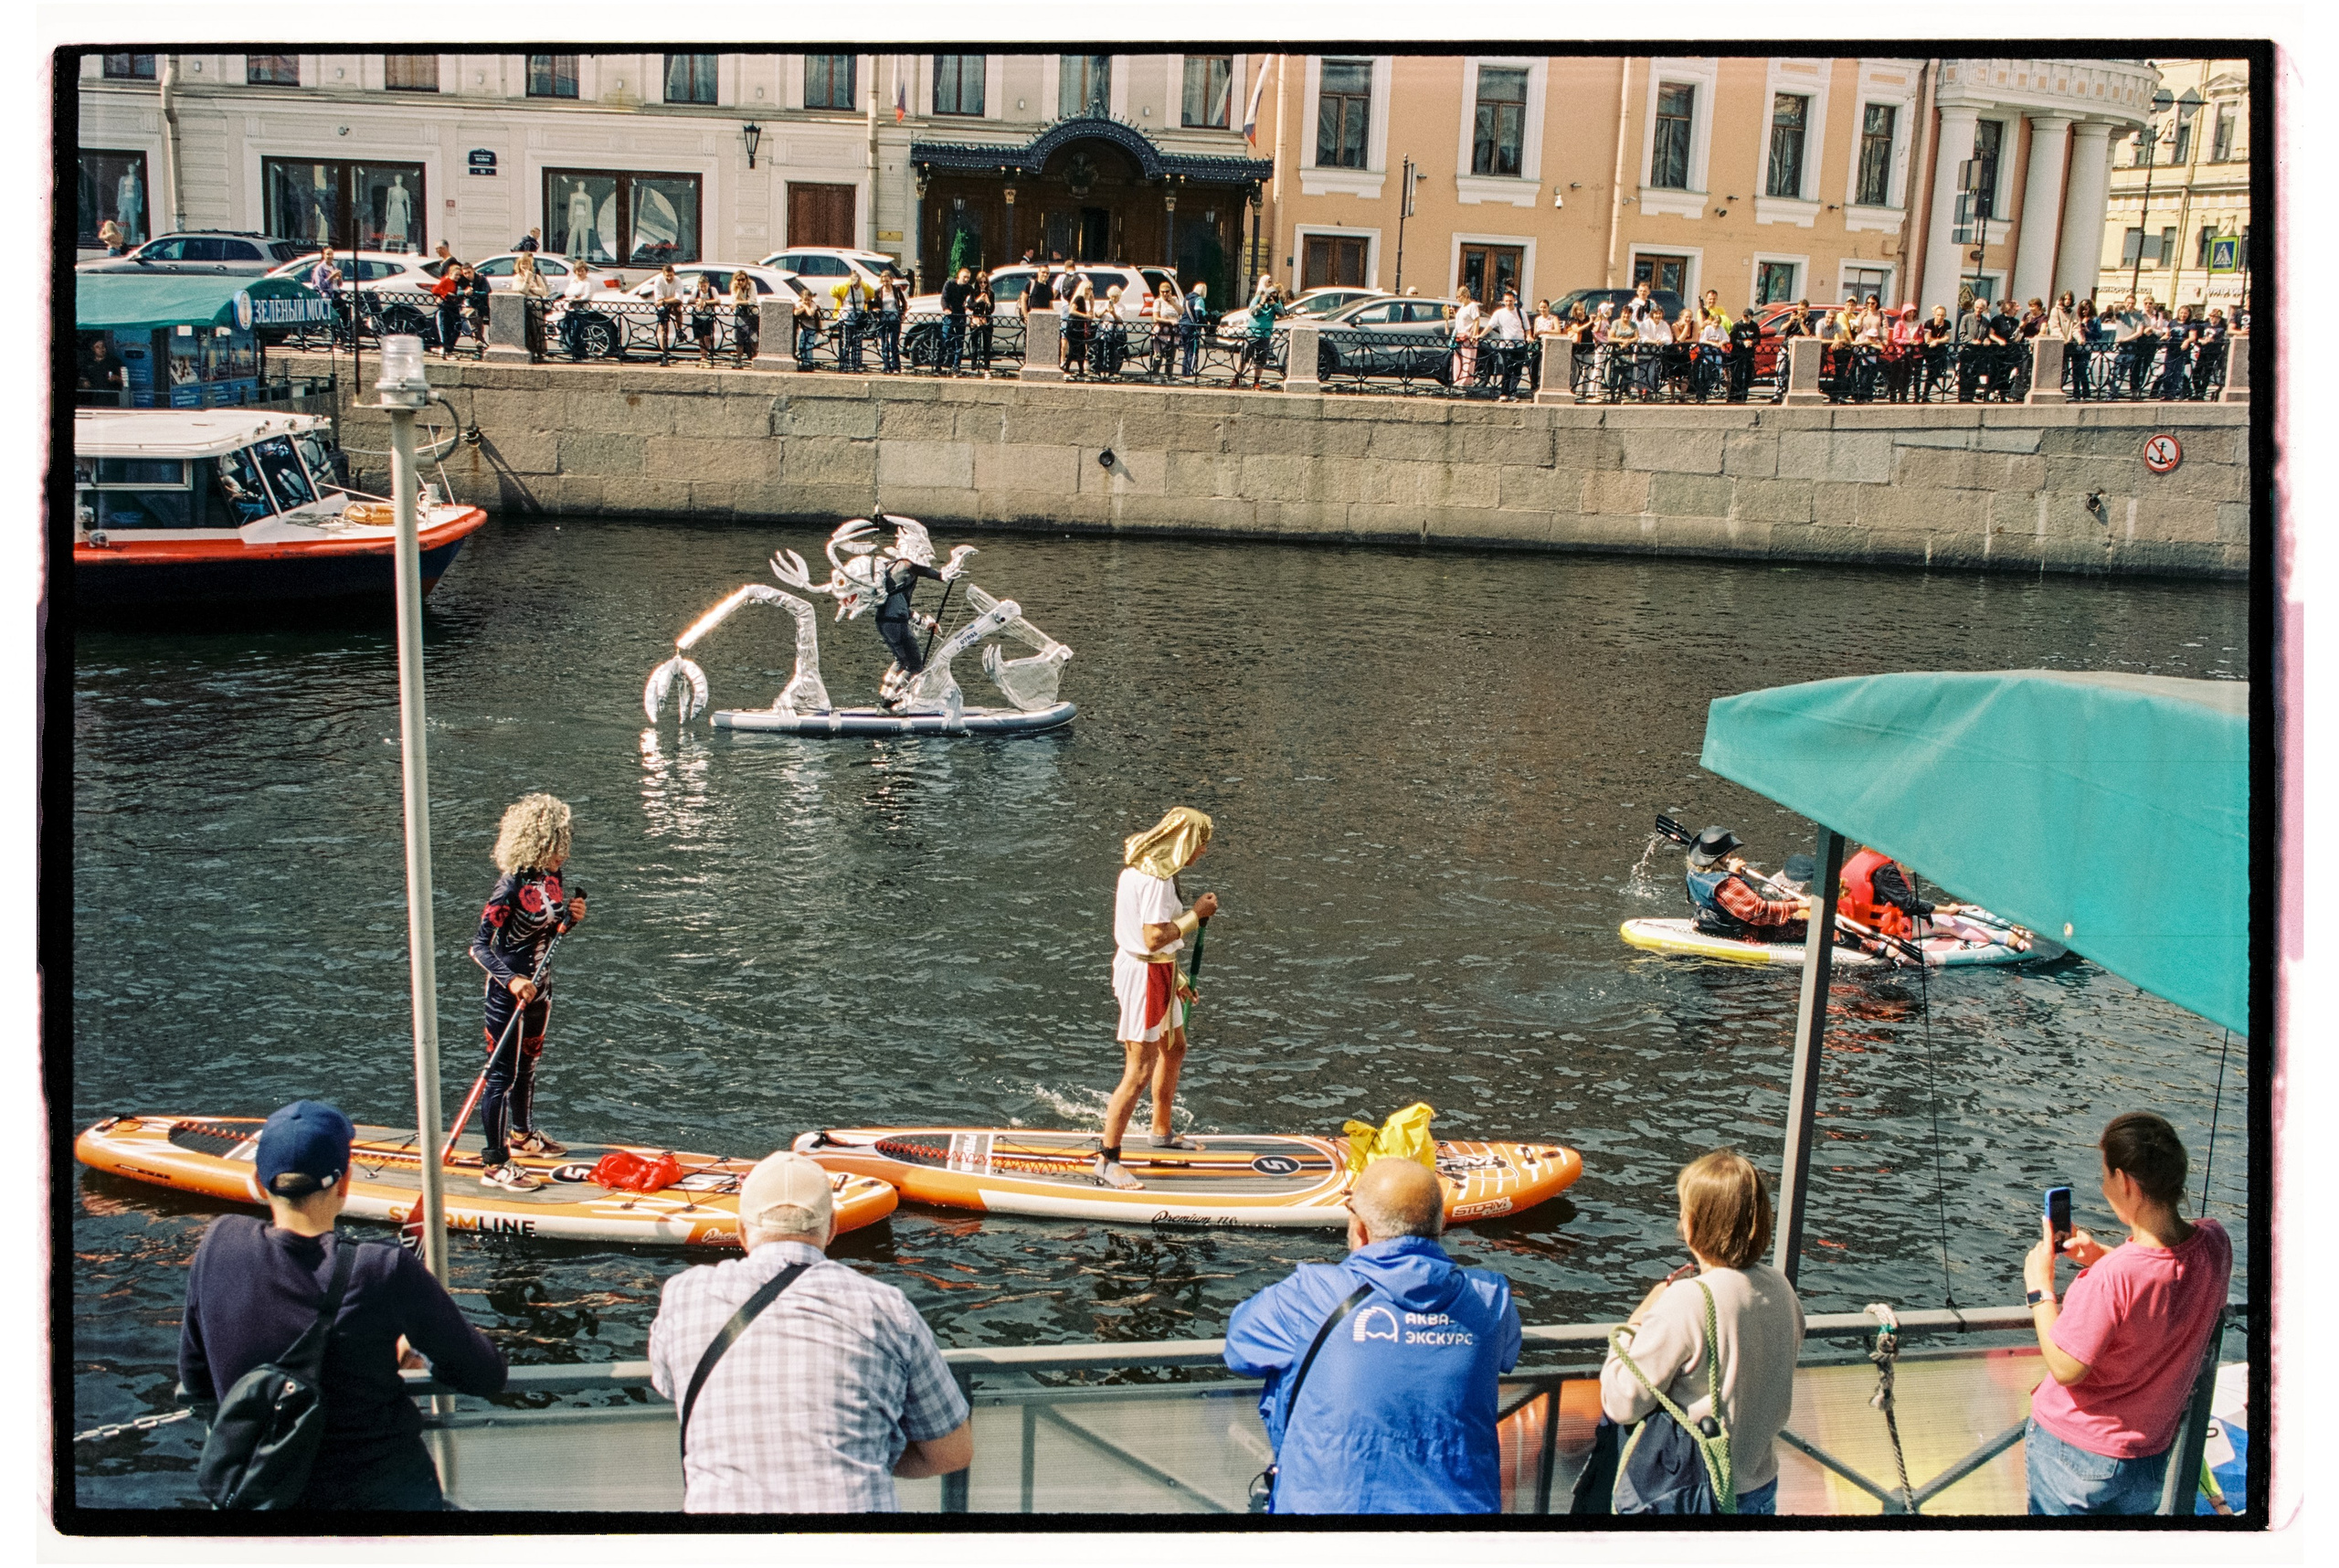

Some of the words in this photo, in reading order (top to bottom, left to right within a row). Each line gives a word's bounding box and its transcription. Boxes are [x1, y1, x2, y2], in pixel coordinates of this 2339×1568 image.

[255, 292, 304, 323] ЗЕЛЁНЫЙ
[306, 298, 332, 321] МОСТ
[1455, 1198, 1509, 1216] STORM
[1151, 1210, 1212, 1224] Premium
[701, 1228, 739, 1245] Prem
[1404, 1312, 1455, 1326] АКВА-
[1404, 1330, 1473, 1345] ЭКСКУРС
